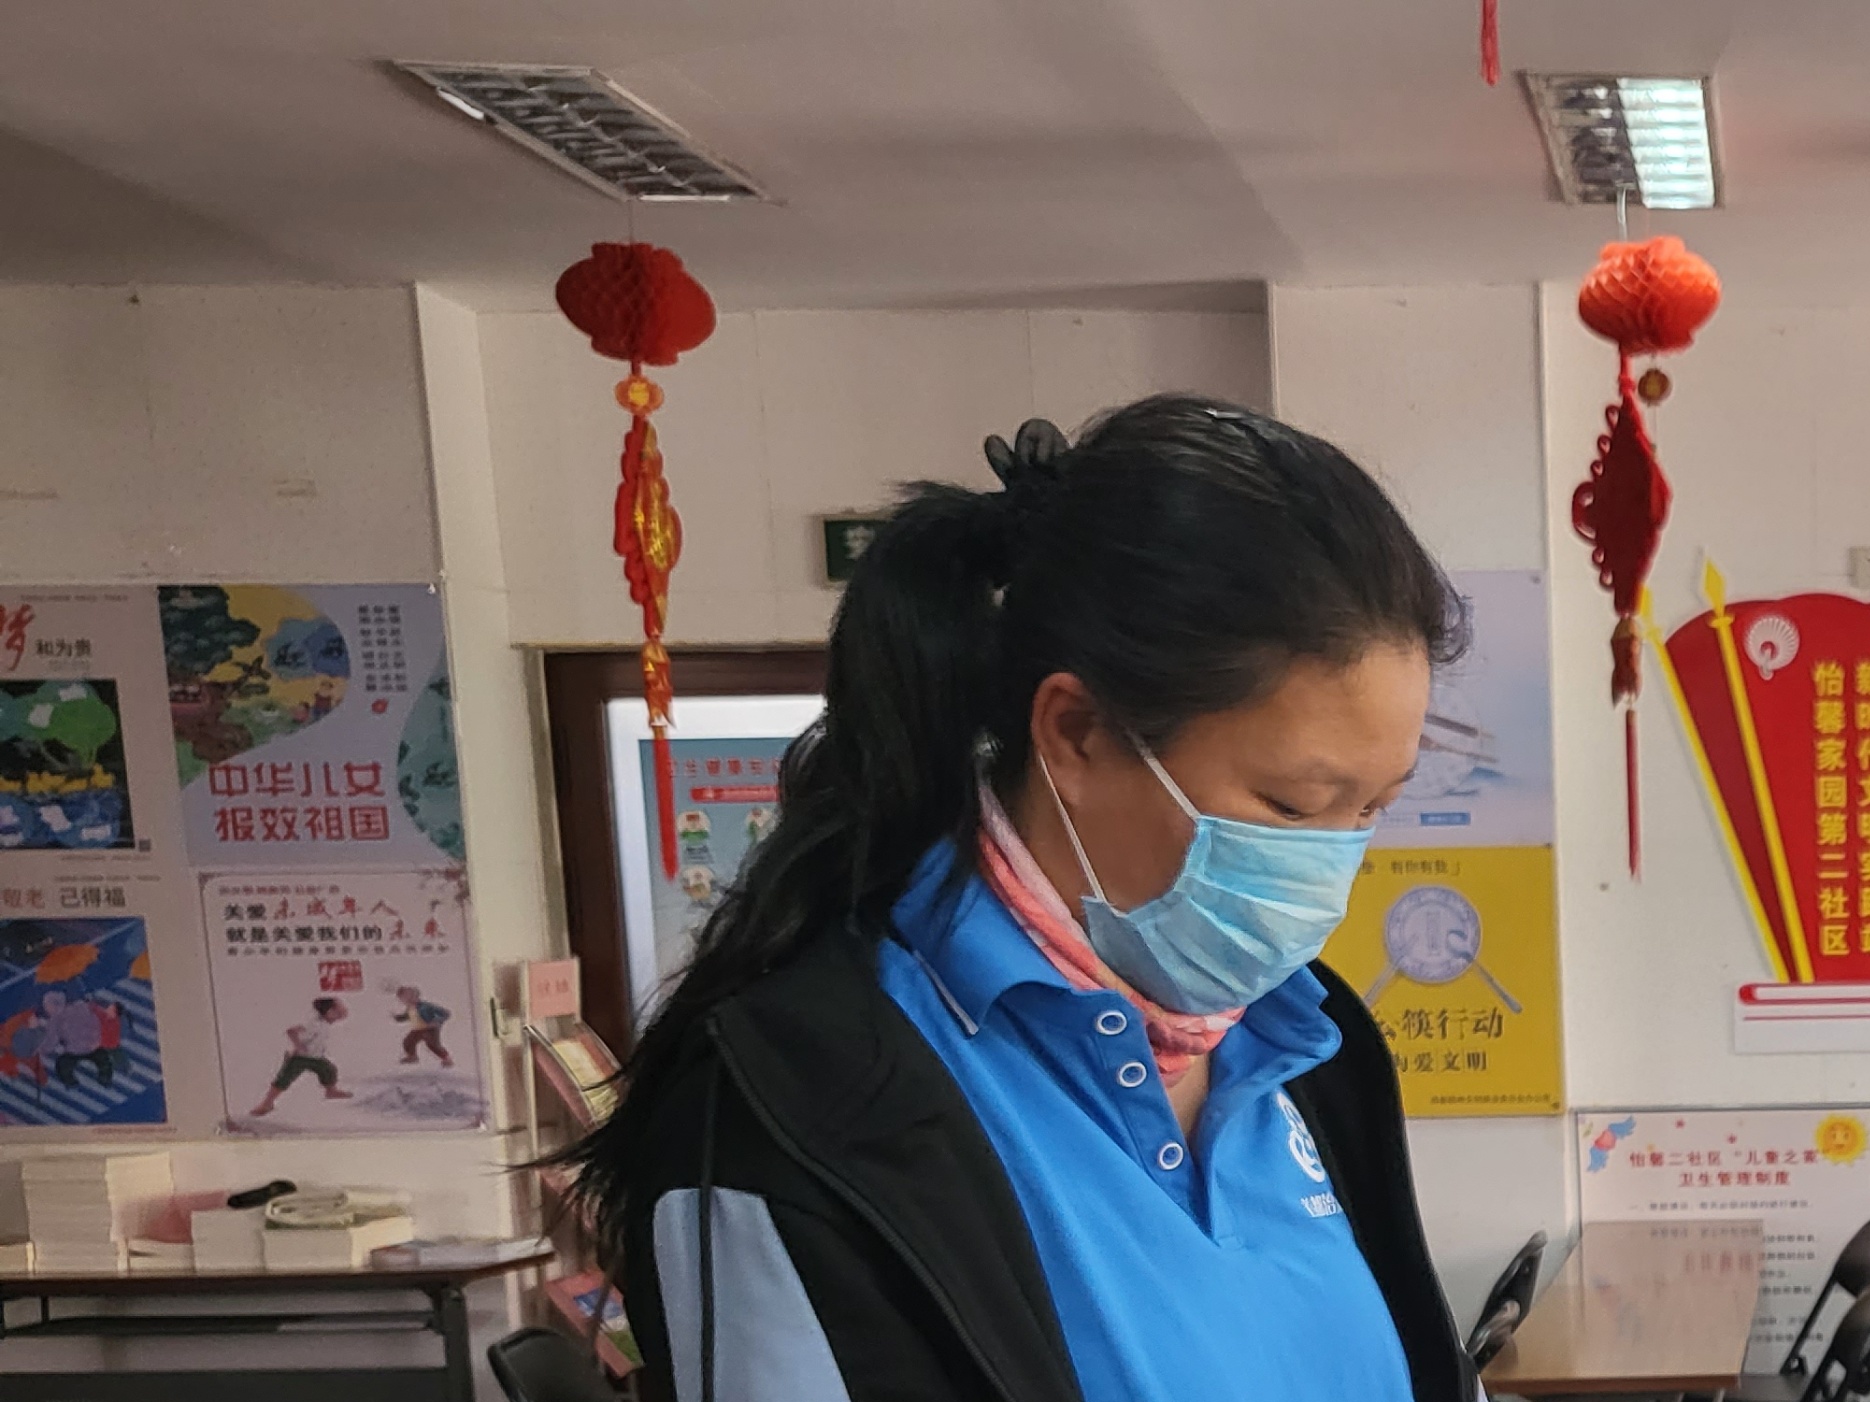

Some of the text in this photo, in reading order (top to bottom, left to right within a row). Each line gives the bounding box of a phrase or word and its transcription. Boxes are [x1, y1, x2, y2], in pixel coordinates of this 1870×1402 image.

[209, 761, 386, 798] 中华儿女
[214, 806, 390, 841] 报效祖国
[1813, 660, 1850, 956] 怡馨家园第二社区
[1679, 1170, 1790, 1188] 卫生管理制度
